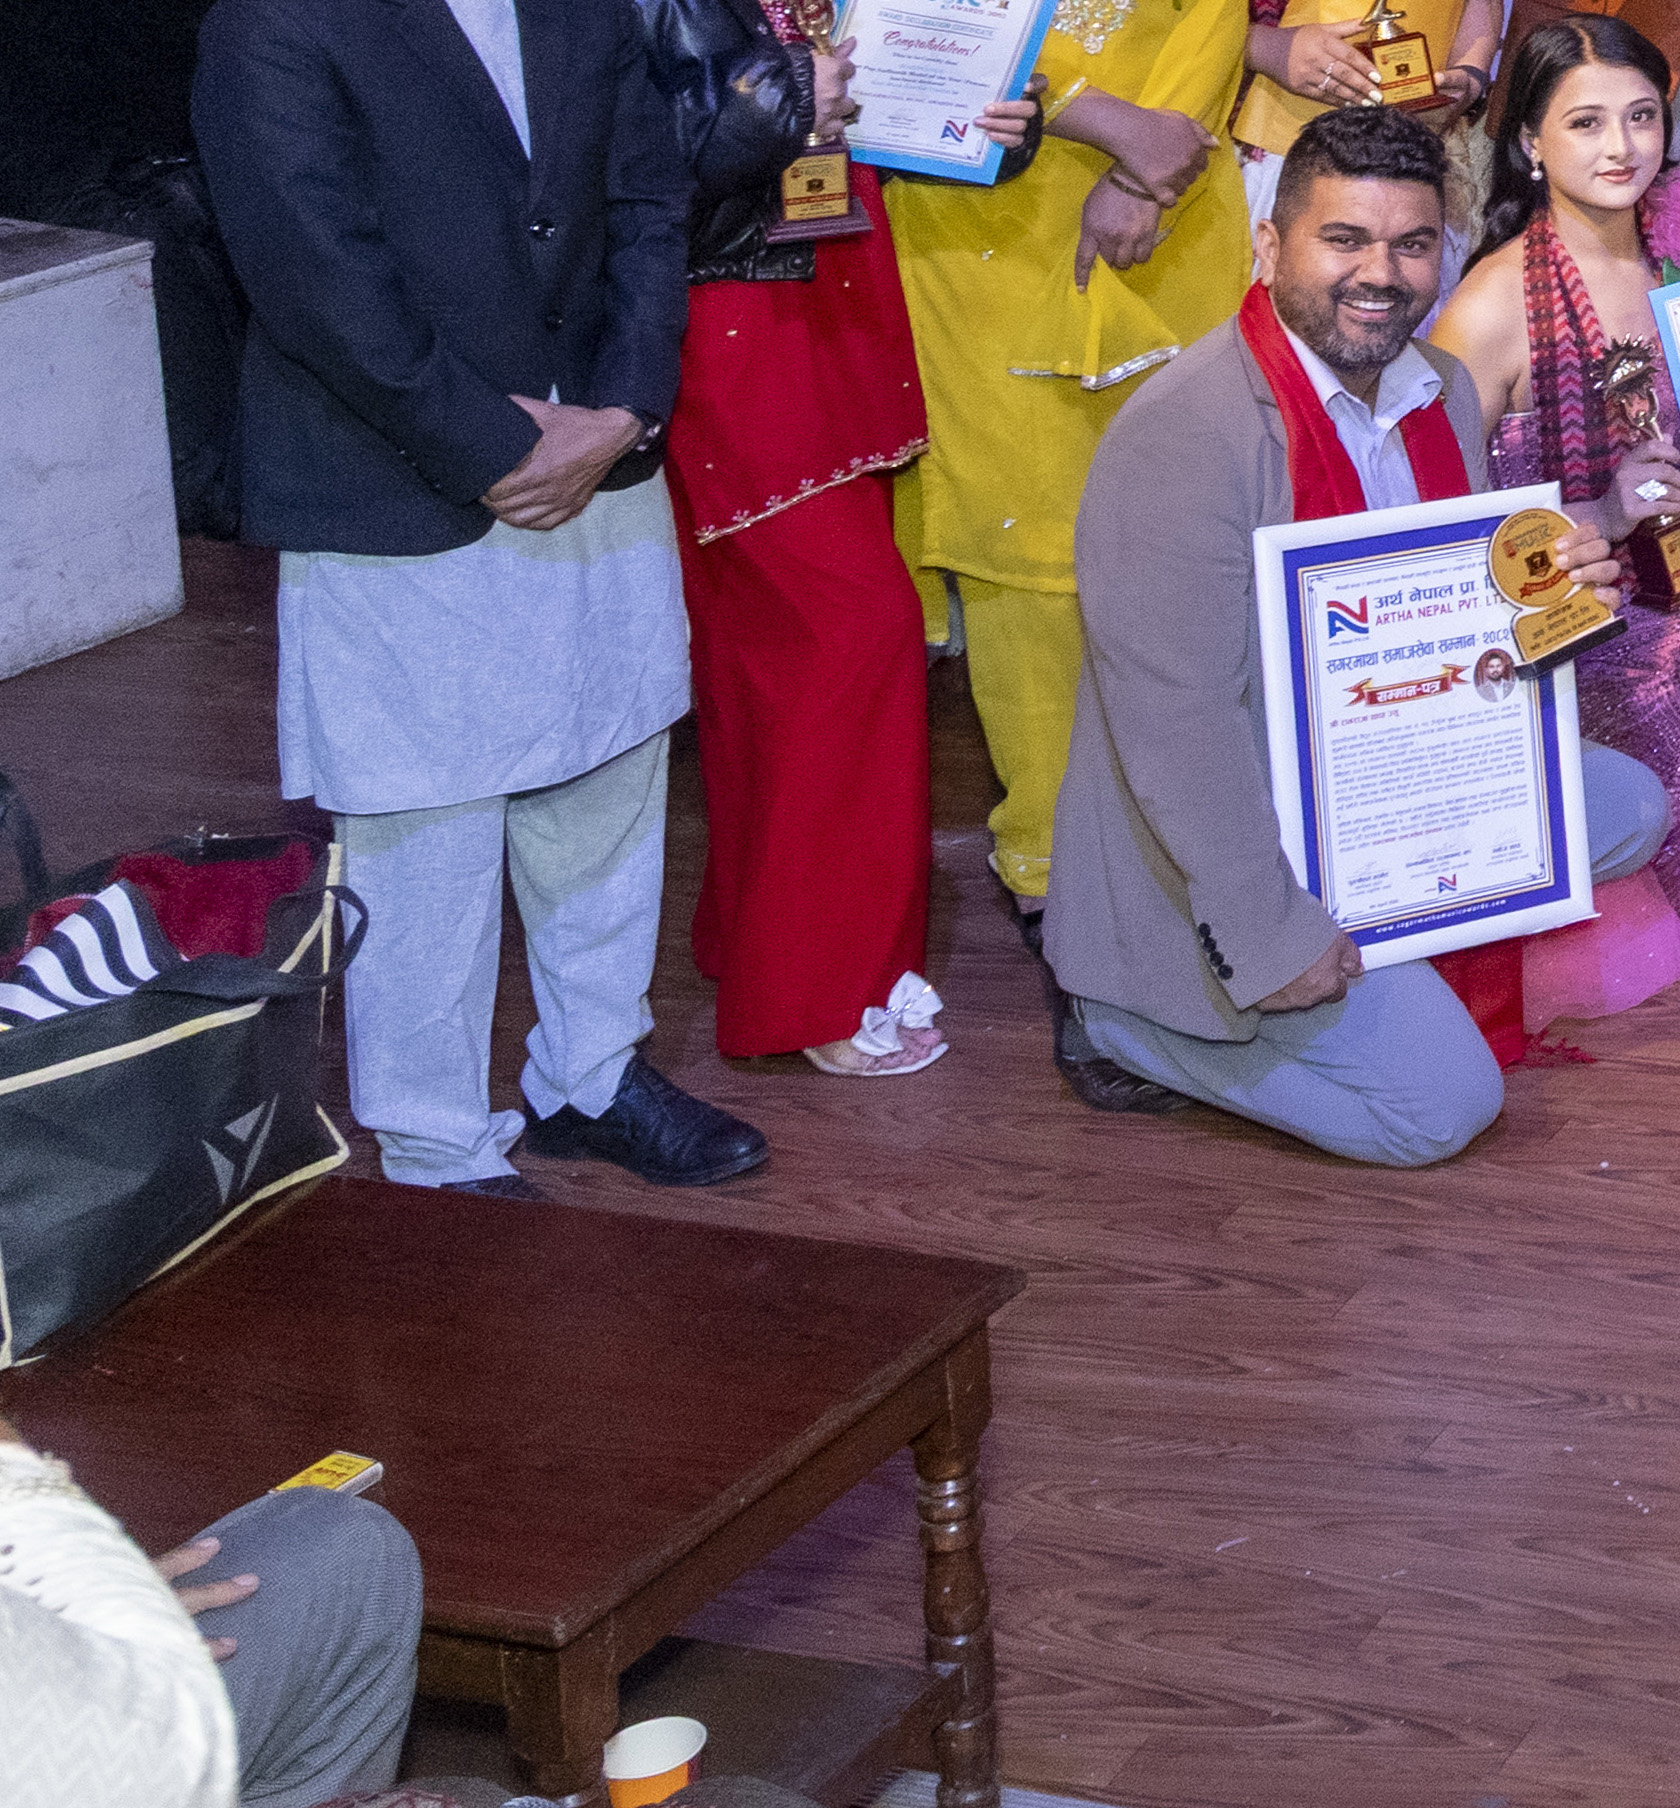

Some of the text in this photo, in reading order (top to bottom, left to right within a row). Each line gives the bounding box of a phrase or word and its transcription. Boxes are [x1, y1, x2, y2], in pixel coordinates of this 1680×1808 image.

[1373, 590, 1403, 609] अर्थ
[1409, 584, 1453, 603] नेपाल
[1375, 610, 1413, 627] ARTHA
[1418, 605, 1454, 619] NEPAL
[1458, 598, 1481, 612] PVT.
